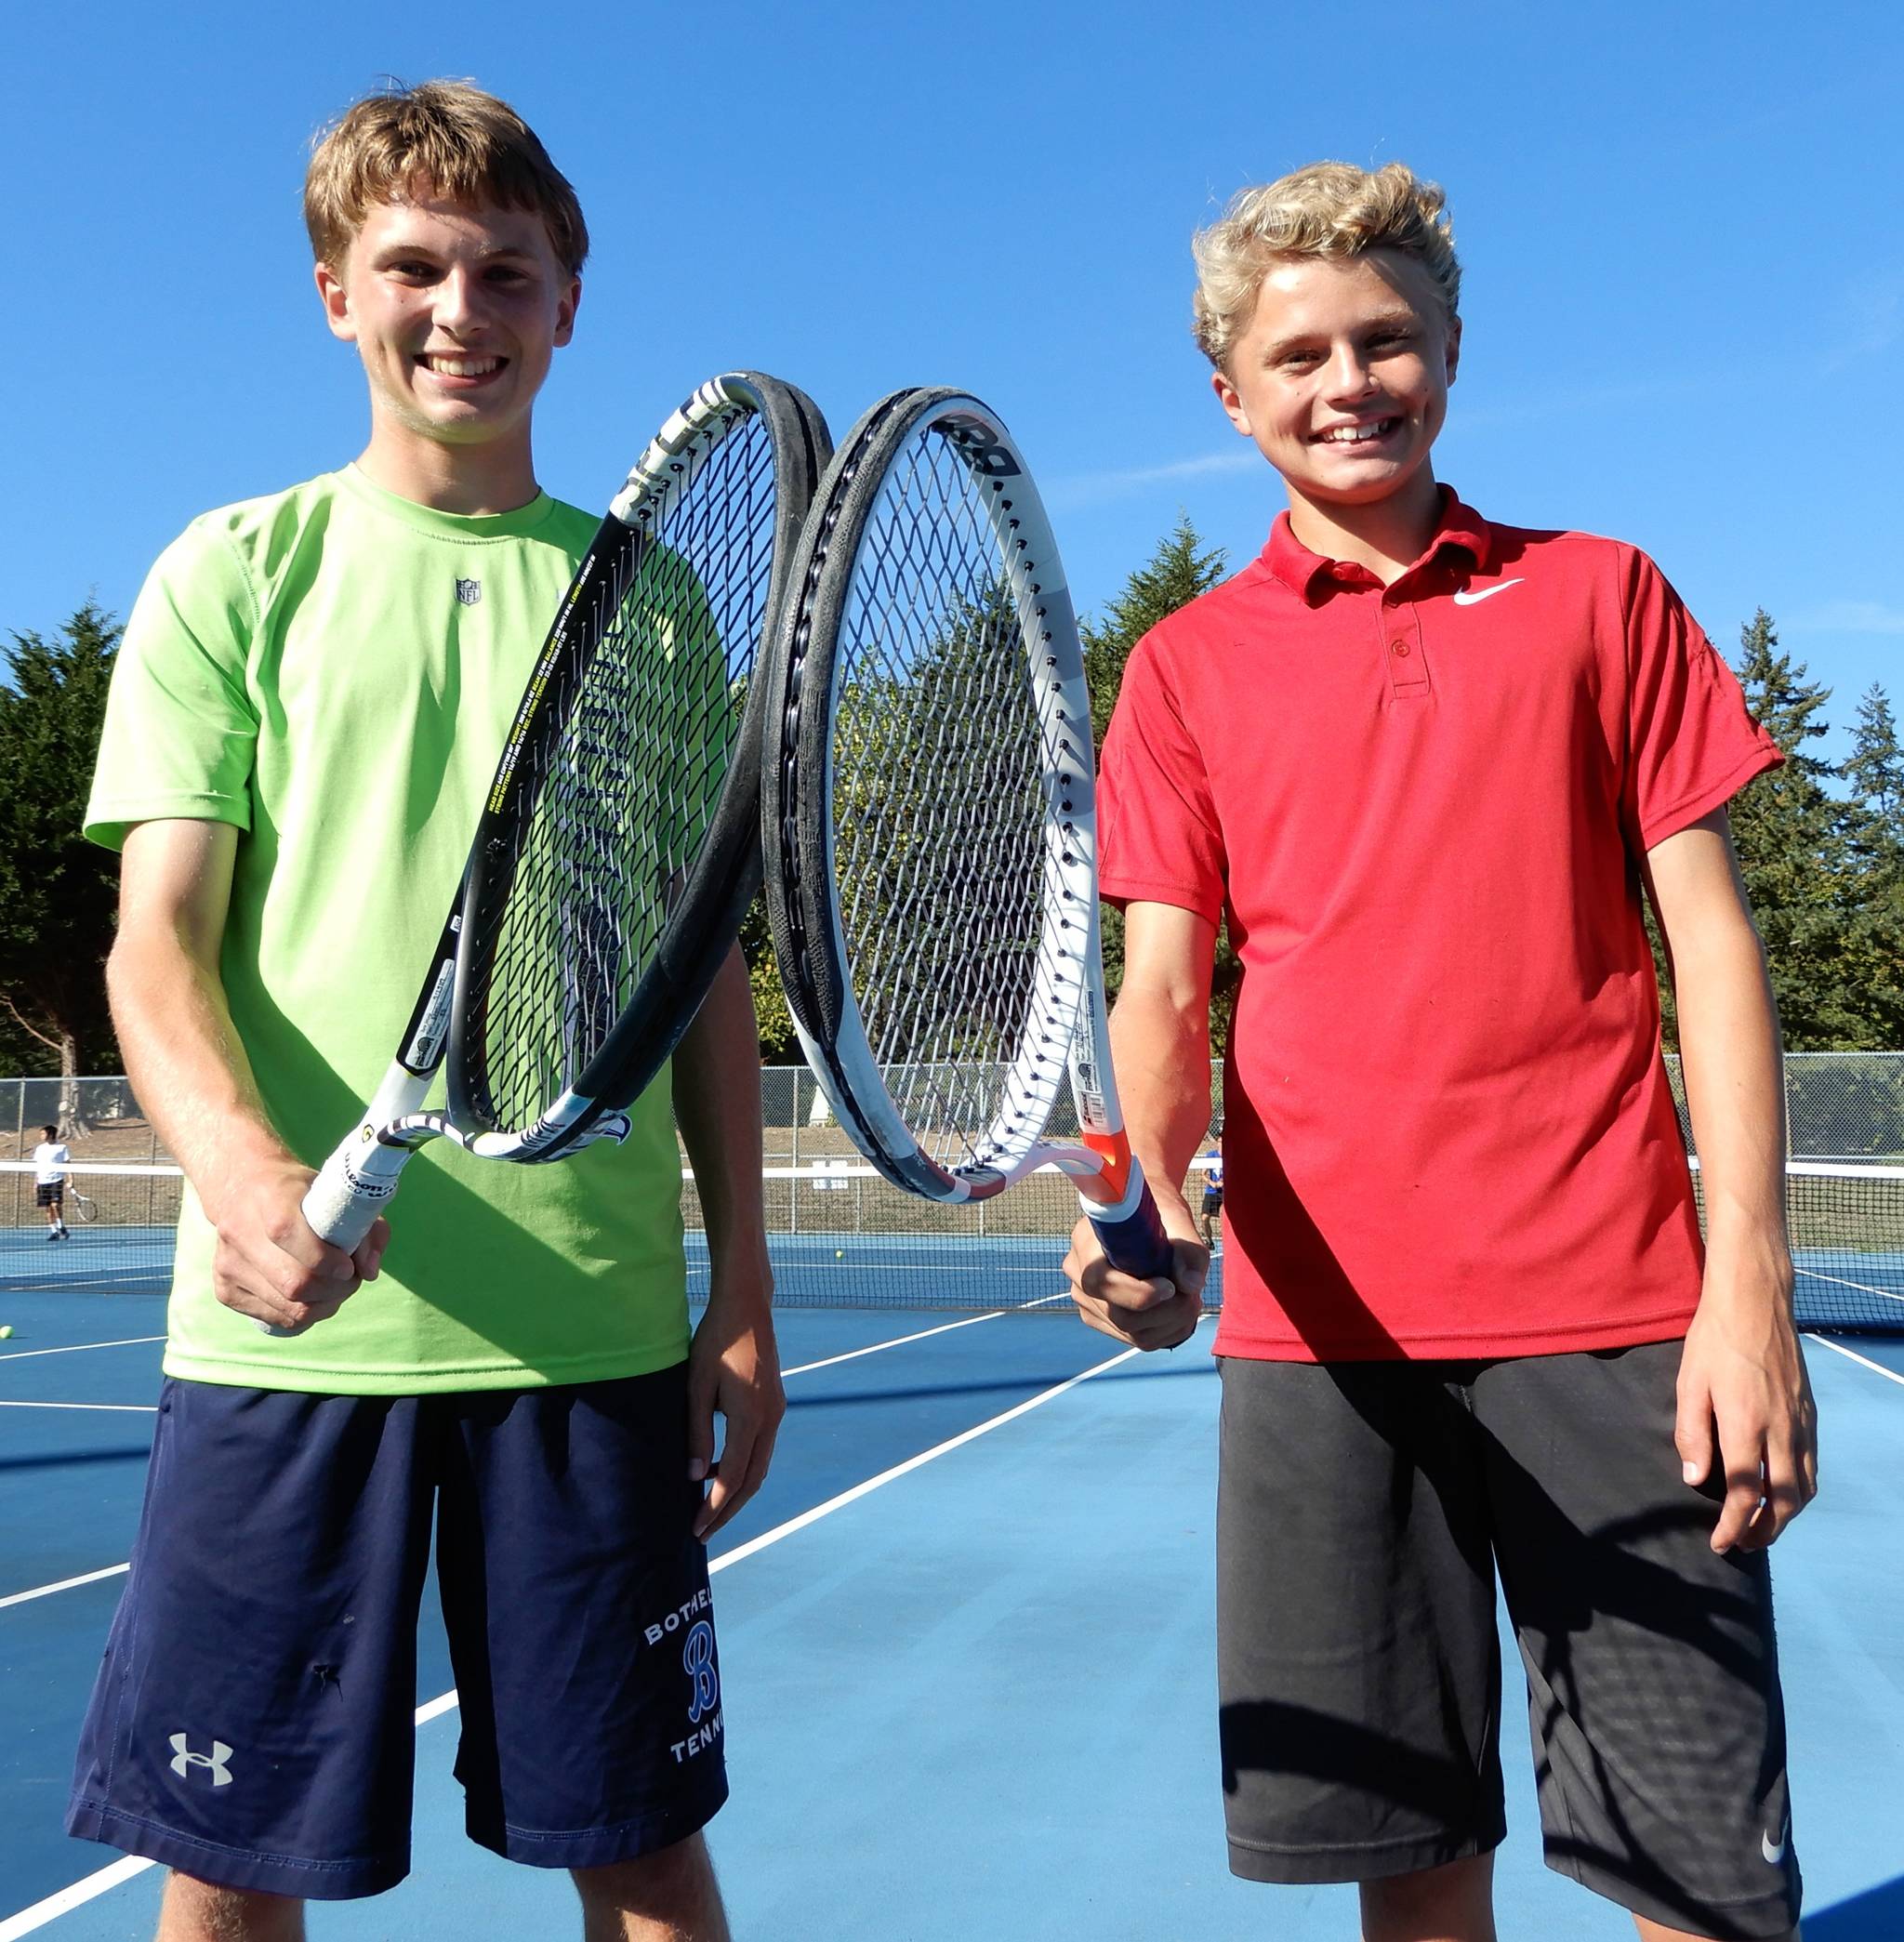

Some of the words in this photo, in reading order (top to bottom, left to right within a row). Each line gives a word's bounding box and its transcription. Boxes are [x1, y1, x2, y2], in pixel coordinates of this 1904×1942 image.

[458, 589, 479, 602] NFL
[545, 638, 558, 662] BALANCE
[571, 584, 583, 604] LENGTH
[501, 771, 512, 795] PATTERN
[683, 1620, 717, 1724] B
